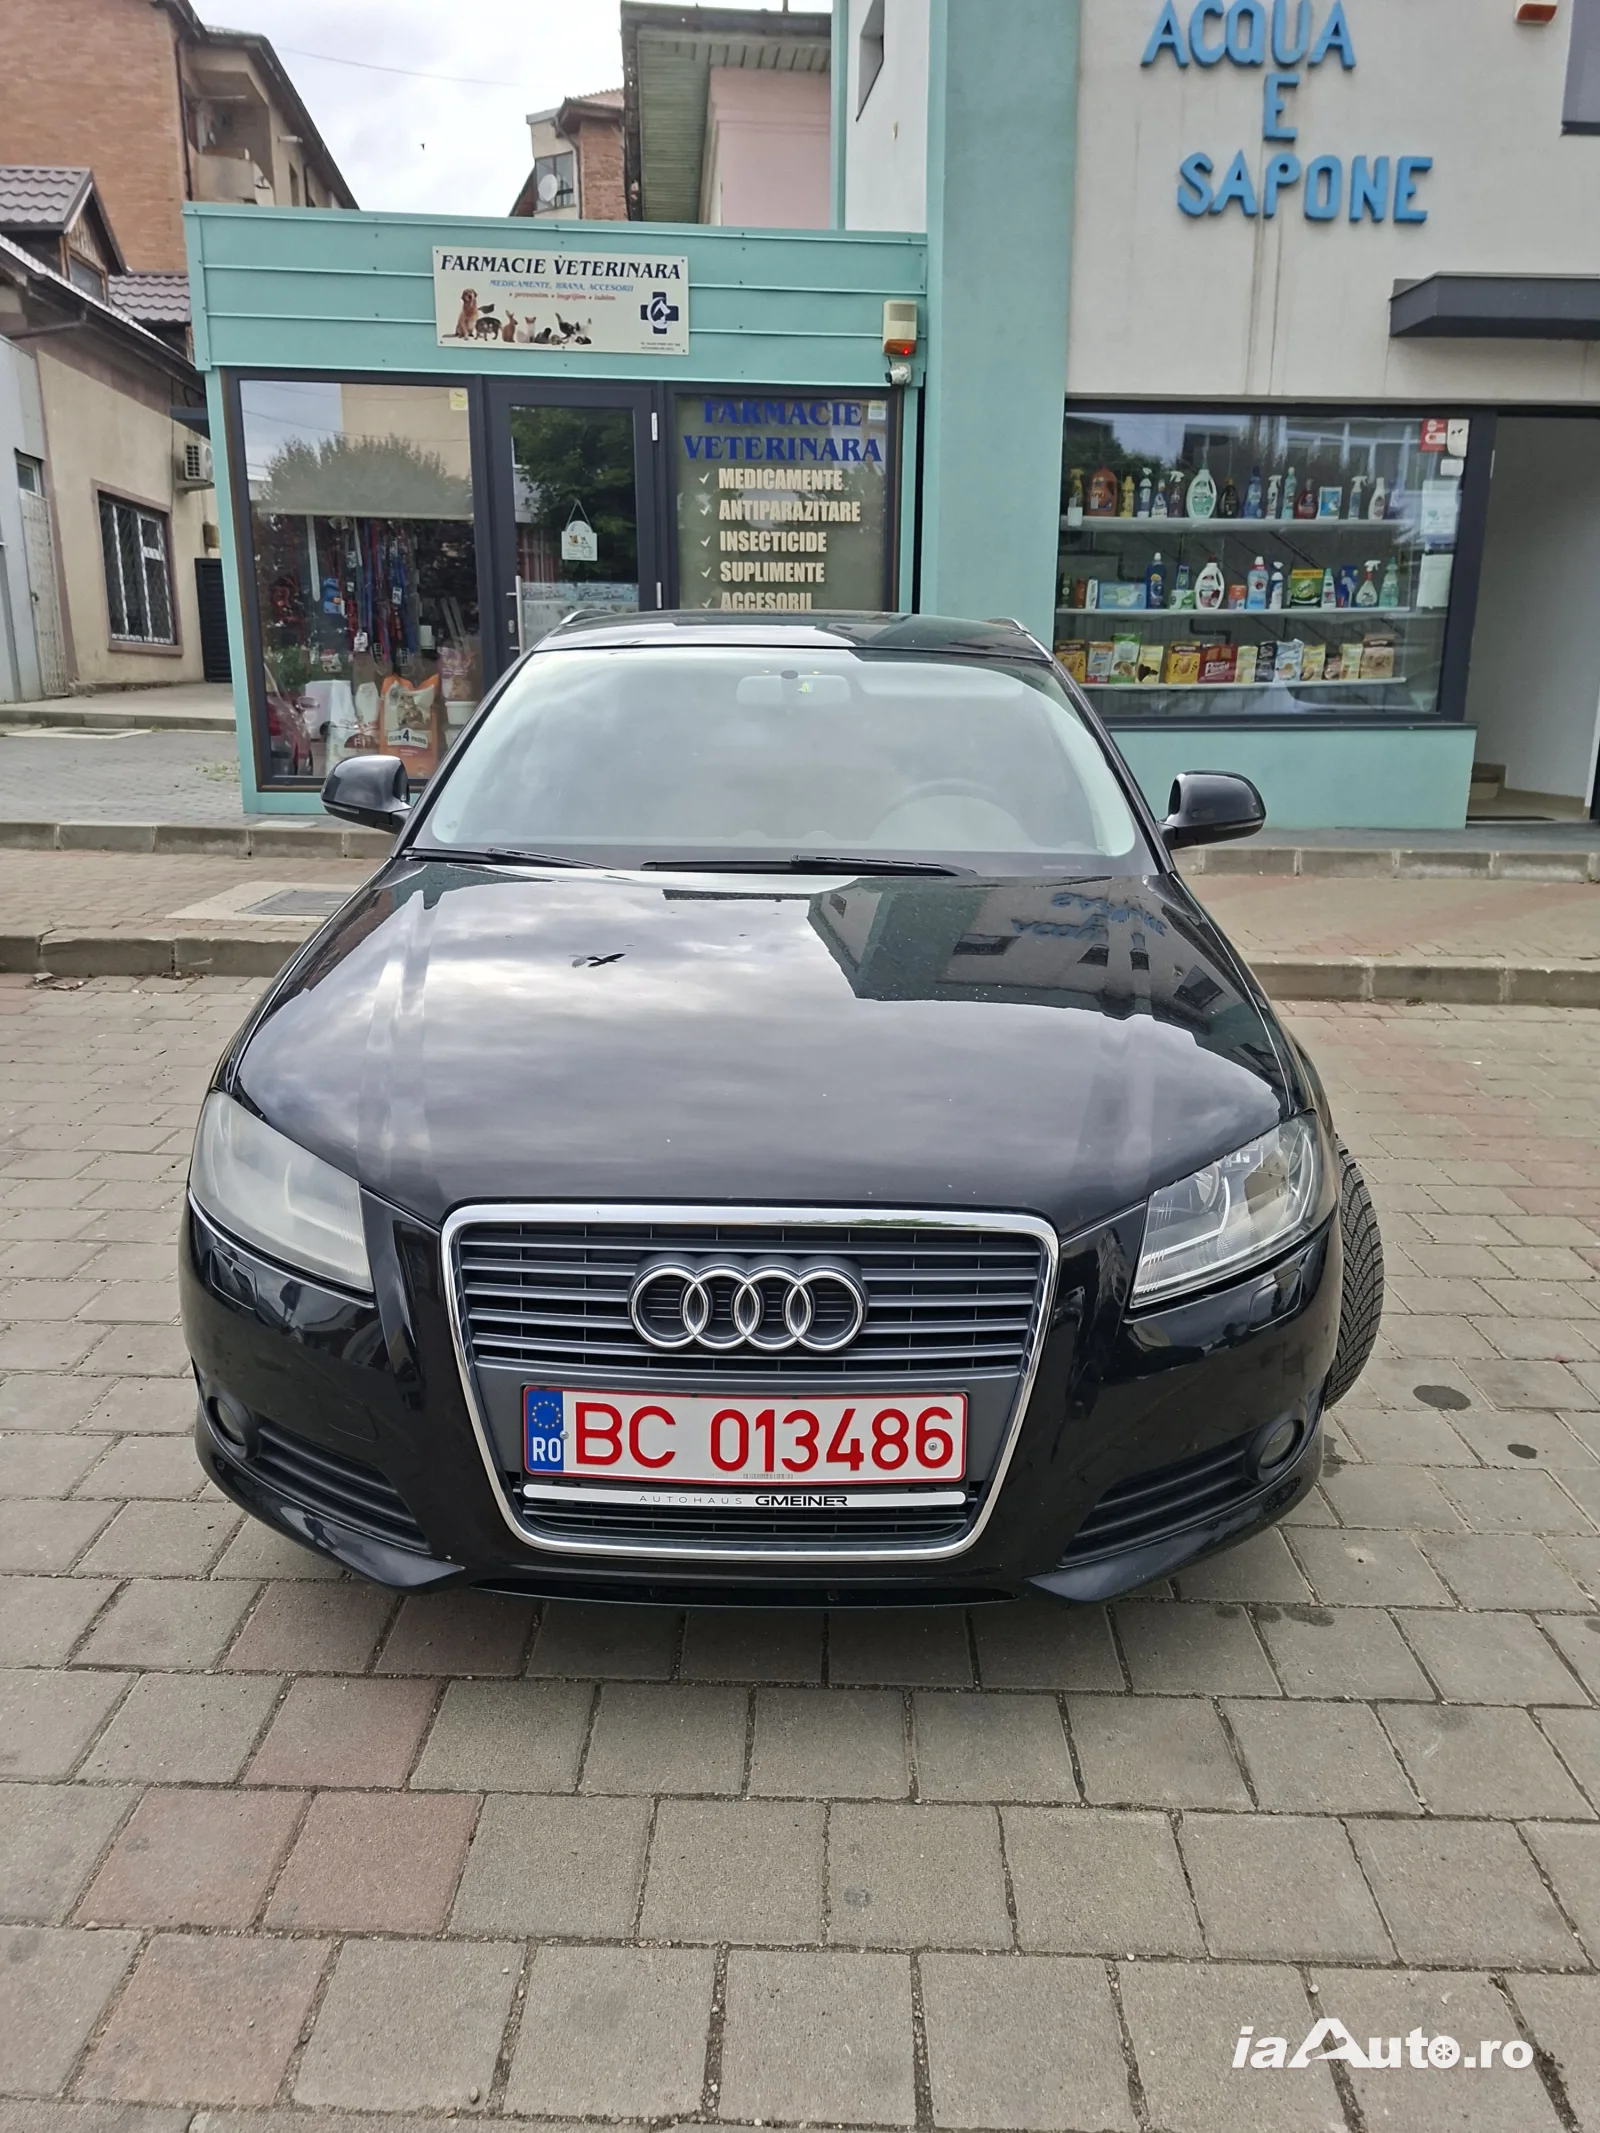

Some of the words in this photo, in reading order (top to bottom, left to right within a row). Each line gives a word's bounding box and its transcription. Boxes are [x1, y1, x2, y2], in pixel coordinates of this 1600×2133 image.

[1140, 0, 1356, 69] ACQUA
[1262, 73, 1299, 142] E
[1176, 150, 1433, 223] SAPONE
[440, 254, 546, 275] FARMACIE
[553, 258, 681, 280] VETERINARA
[703, 400, 862, 427] FARMACIE
[683, 435, 882, 462] VETERINARA
[718, 468, 844, 491] MEDICAMENTE
[718, 499, 861, 523] ANTIPARAZITARE
[719, 530, 828, 553] INSECTICIDE
[720, 561, 825, 583] SUPLIMENTE
[719, 592, 813, 611] ACCESORII
[402, 729, 410, 743] 4
[532, 1436, 562, 1462] RO
[574, 1401, 677, 1469] BC
[710, 1406, 954, 1473] 013486
[638, 1494, 744, 1506] AUTOHAUS
[754, 1494, 849, 1508] GMEINER
